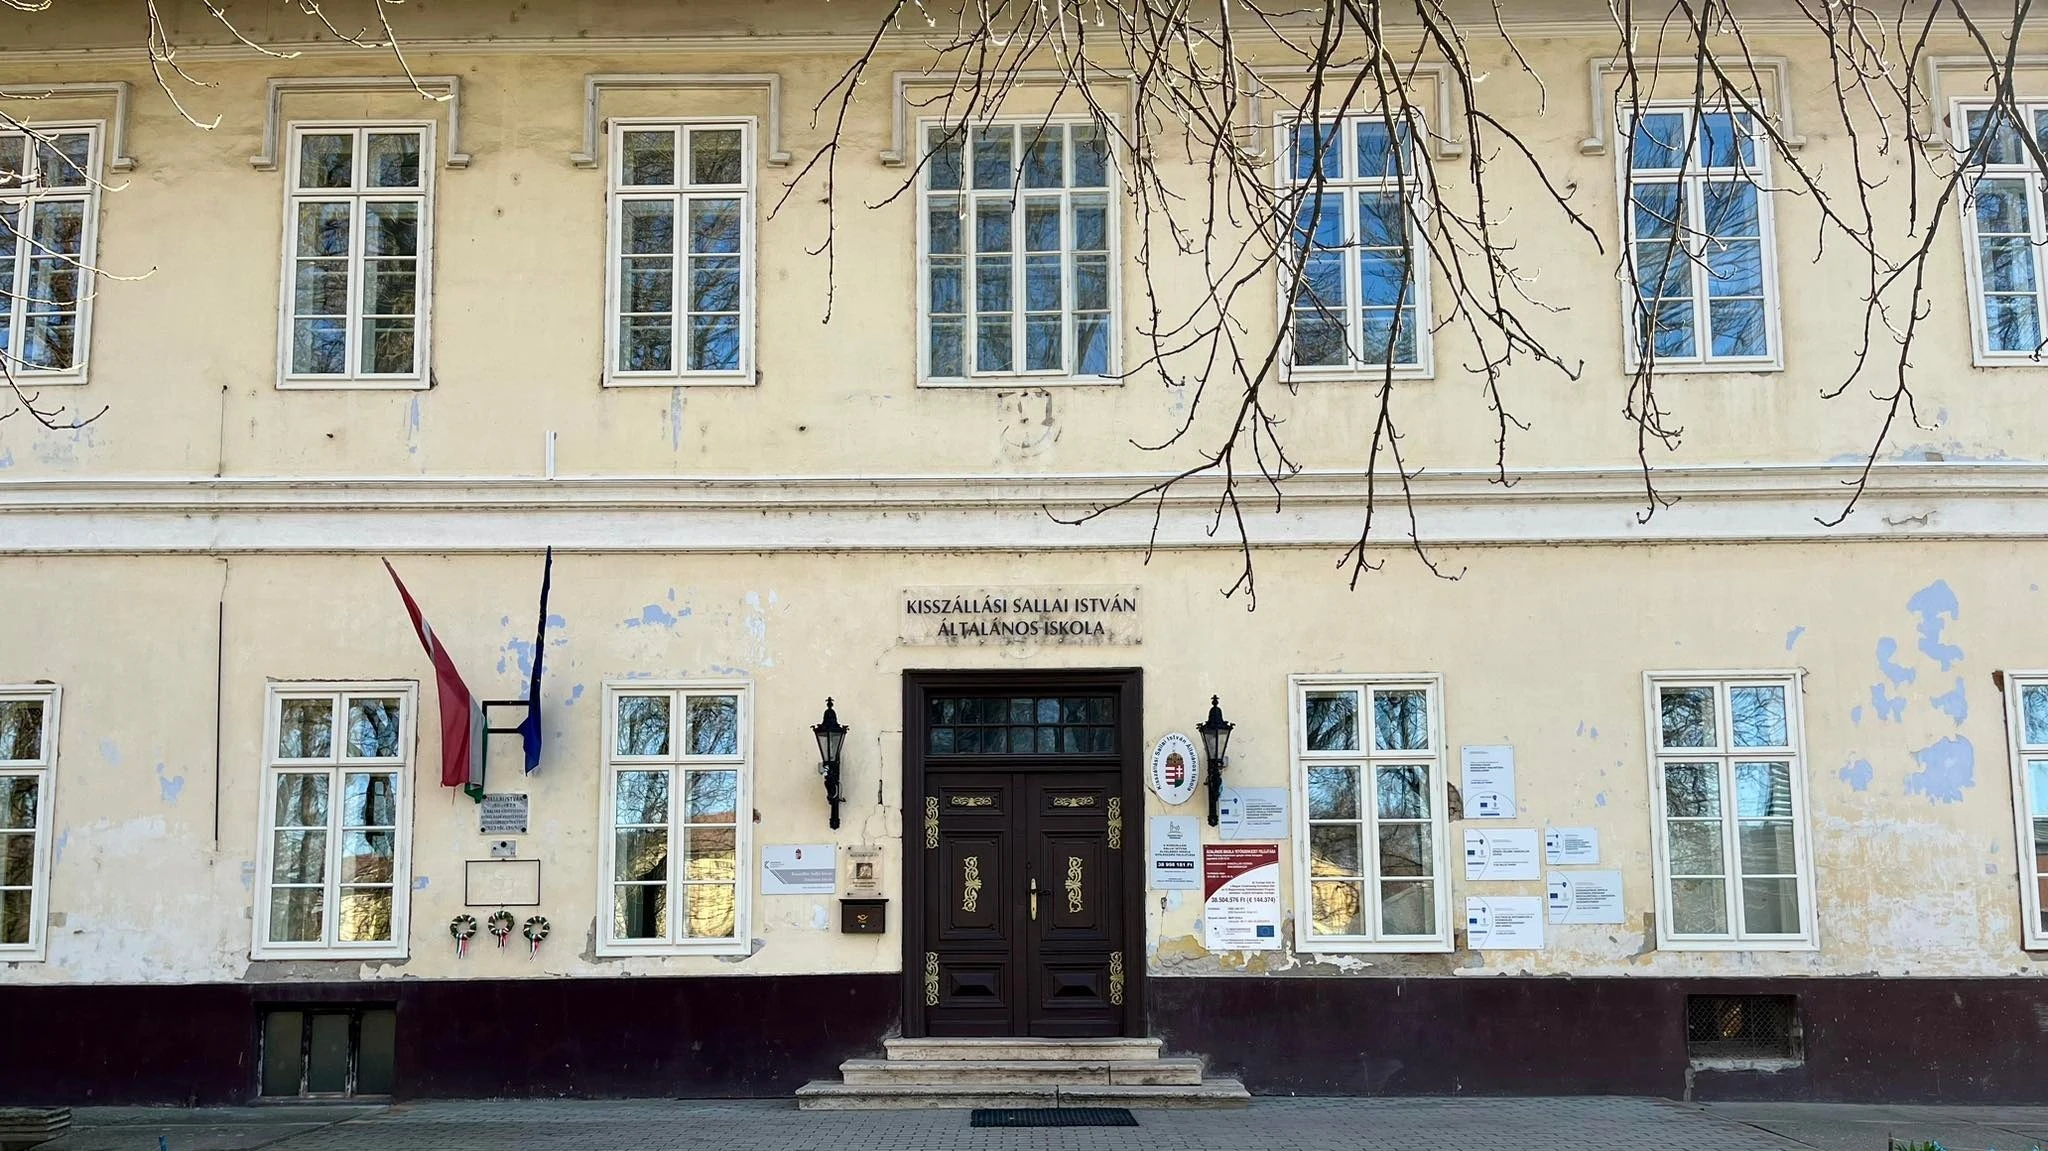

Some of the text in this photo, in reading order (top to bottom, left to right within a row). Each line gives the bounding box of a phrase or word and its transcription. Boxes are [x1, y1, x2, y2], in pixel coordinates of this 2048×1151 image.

[906, 593, 1136, 614] KISSZÁLLÁSI SALLAI ISTVÁN
[937, 617, 1105, 637] ÁLTALÁNOS ISKOLA
[1155, 740, 1167, 756] Sallai
[1167, 735, 1187, 744] István
